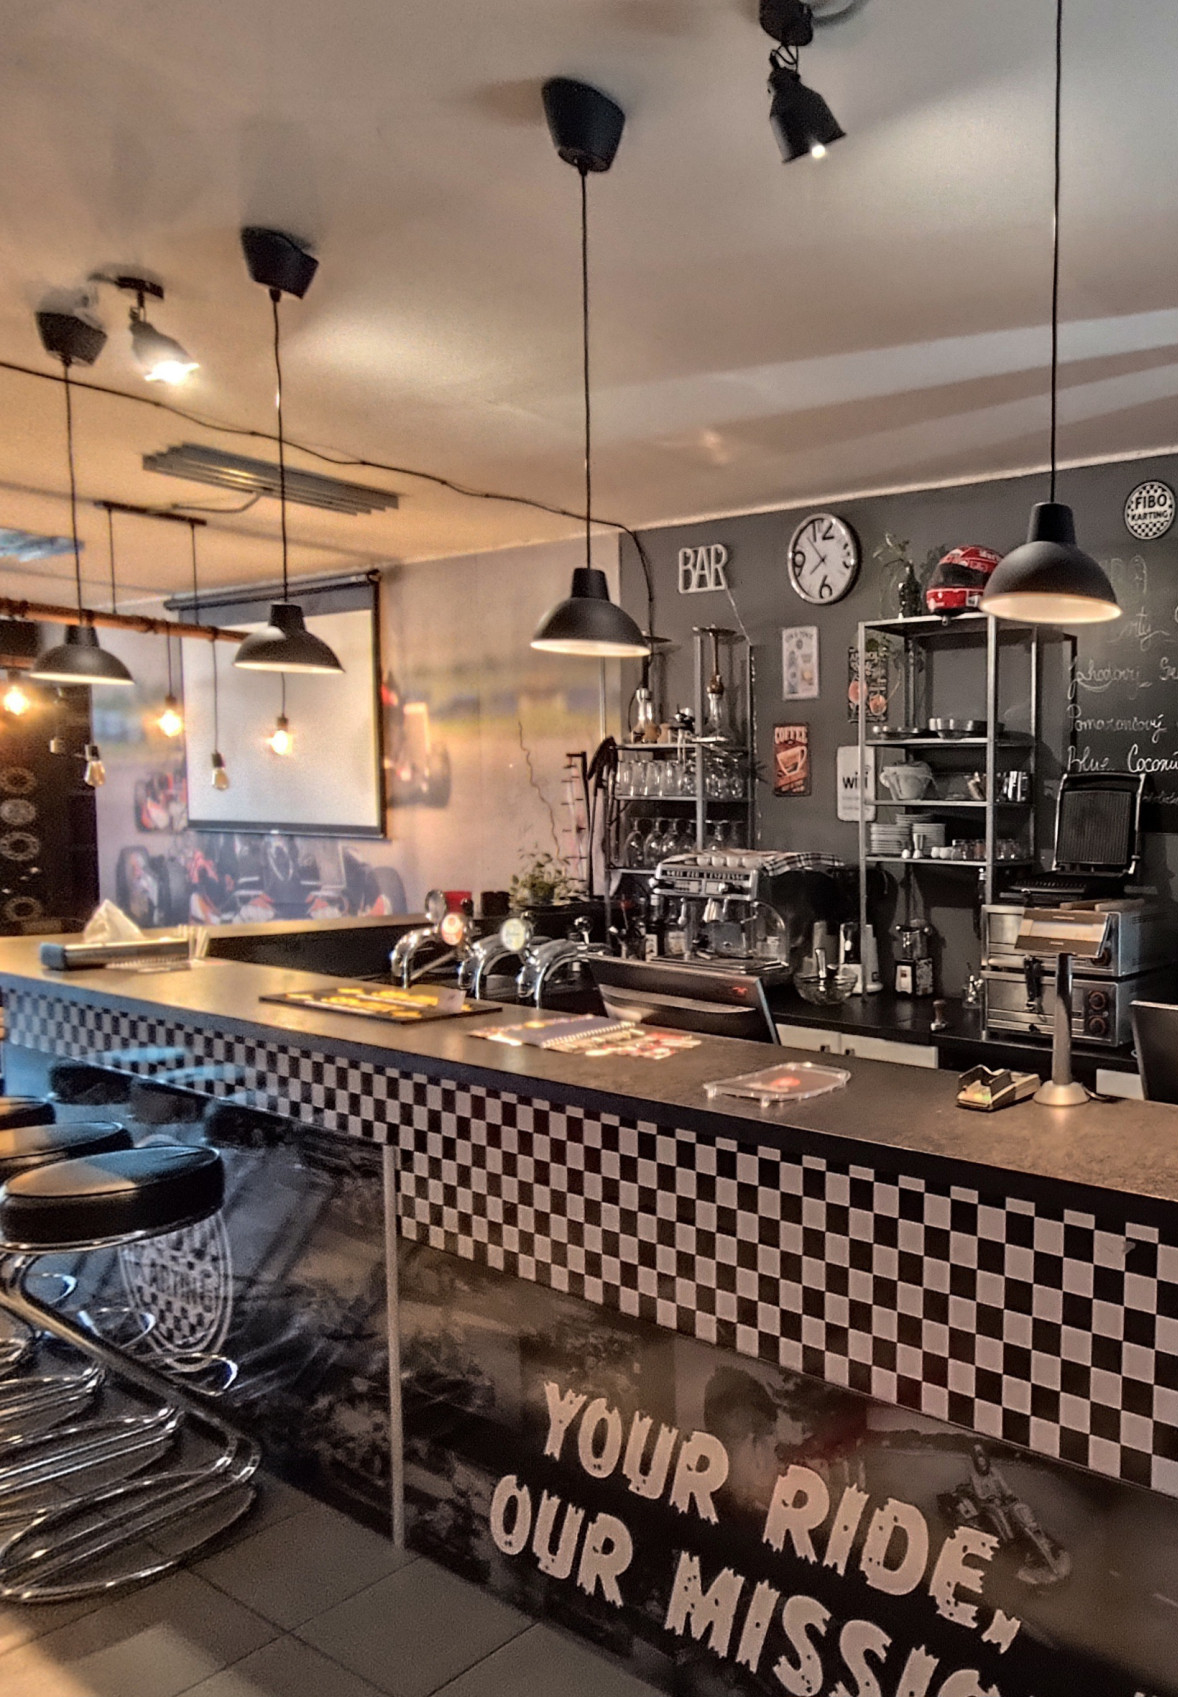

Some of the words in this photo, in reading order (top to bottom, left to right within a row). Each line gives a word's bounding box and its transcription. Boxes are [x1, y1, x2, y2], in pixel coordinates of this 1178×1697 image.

[1135, 494, 1167, 510] FIBO
[1131, 511, 1169, 522] KARTING
[679, 544, 728, 593] BAR
[819, 574, 833, 599] 6
[842, 771, 871, 790] wii
[542, 1381, 730, 1525] YOUR
[763, 1464, 1021, 1654] RIDE,
[490, 1475, 634, 1607] OUR
[664, 1551, 1001, 1697] MISSI
